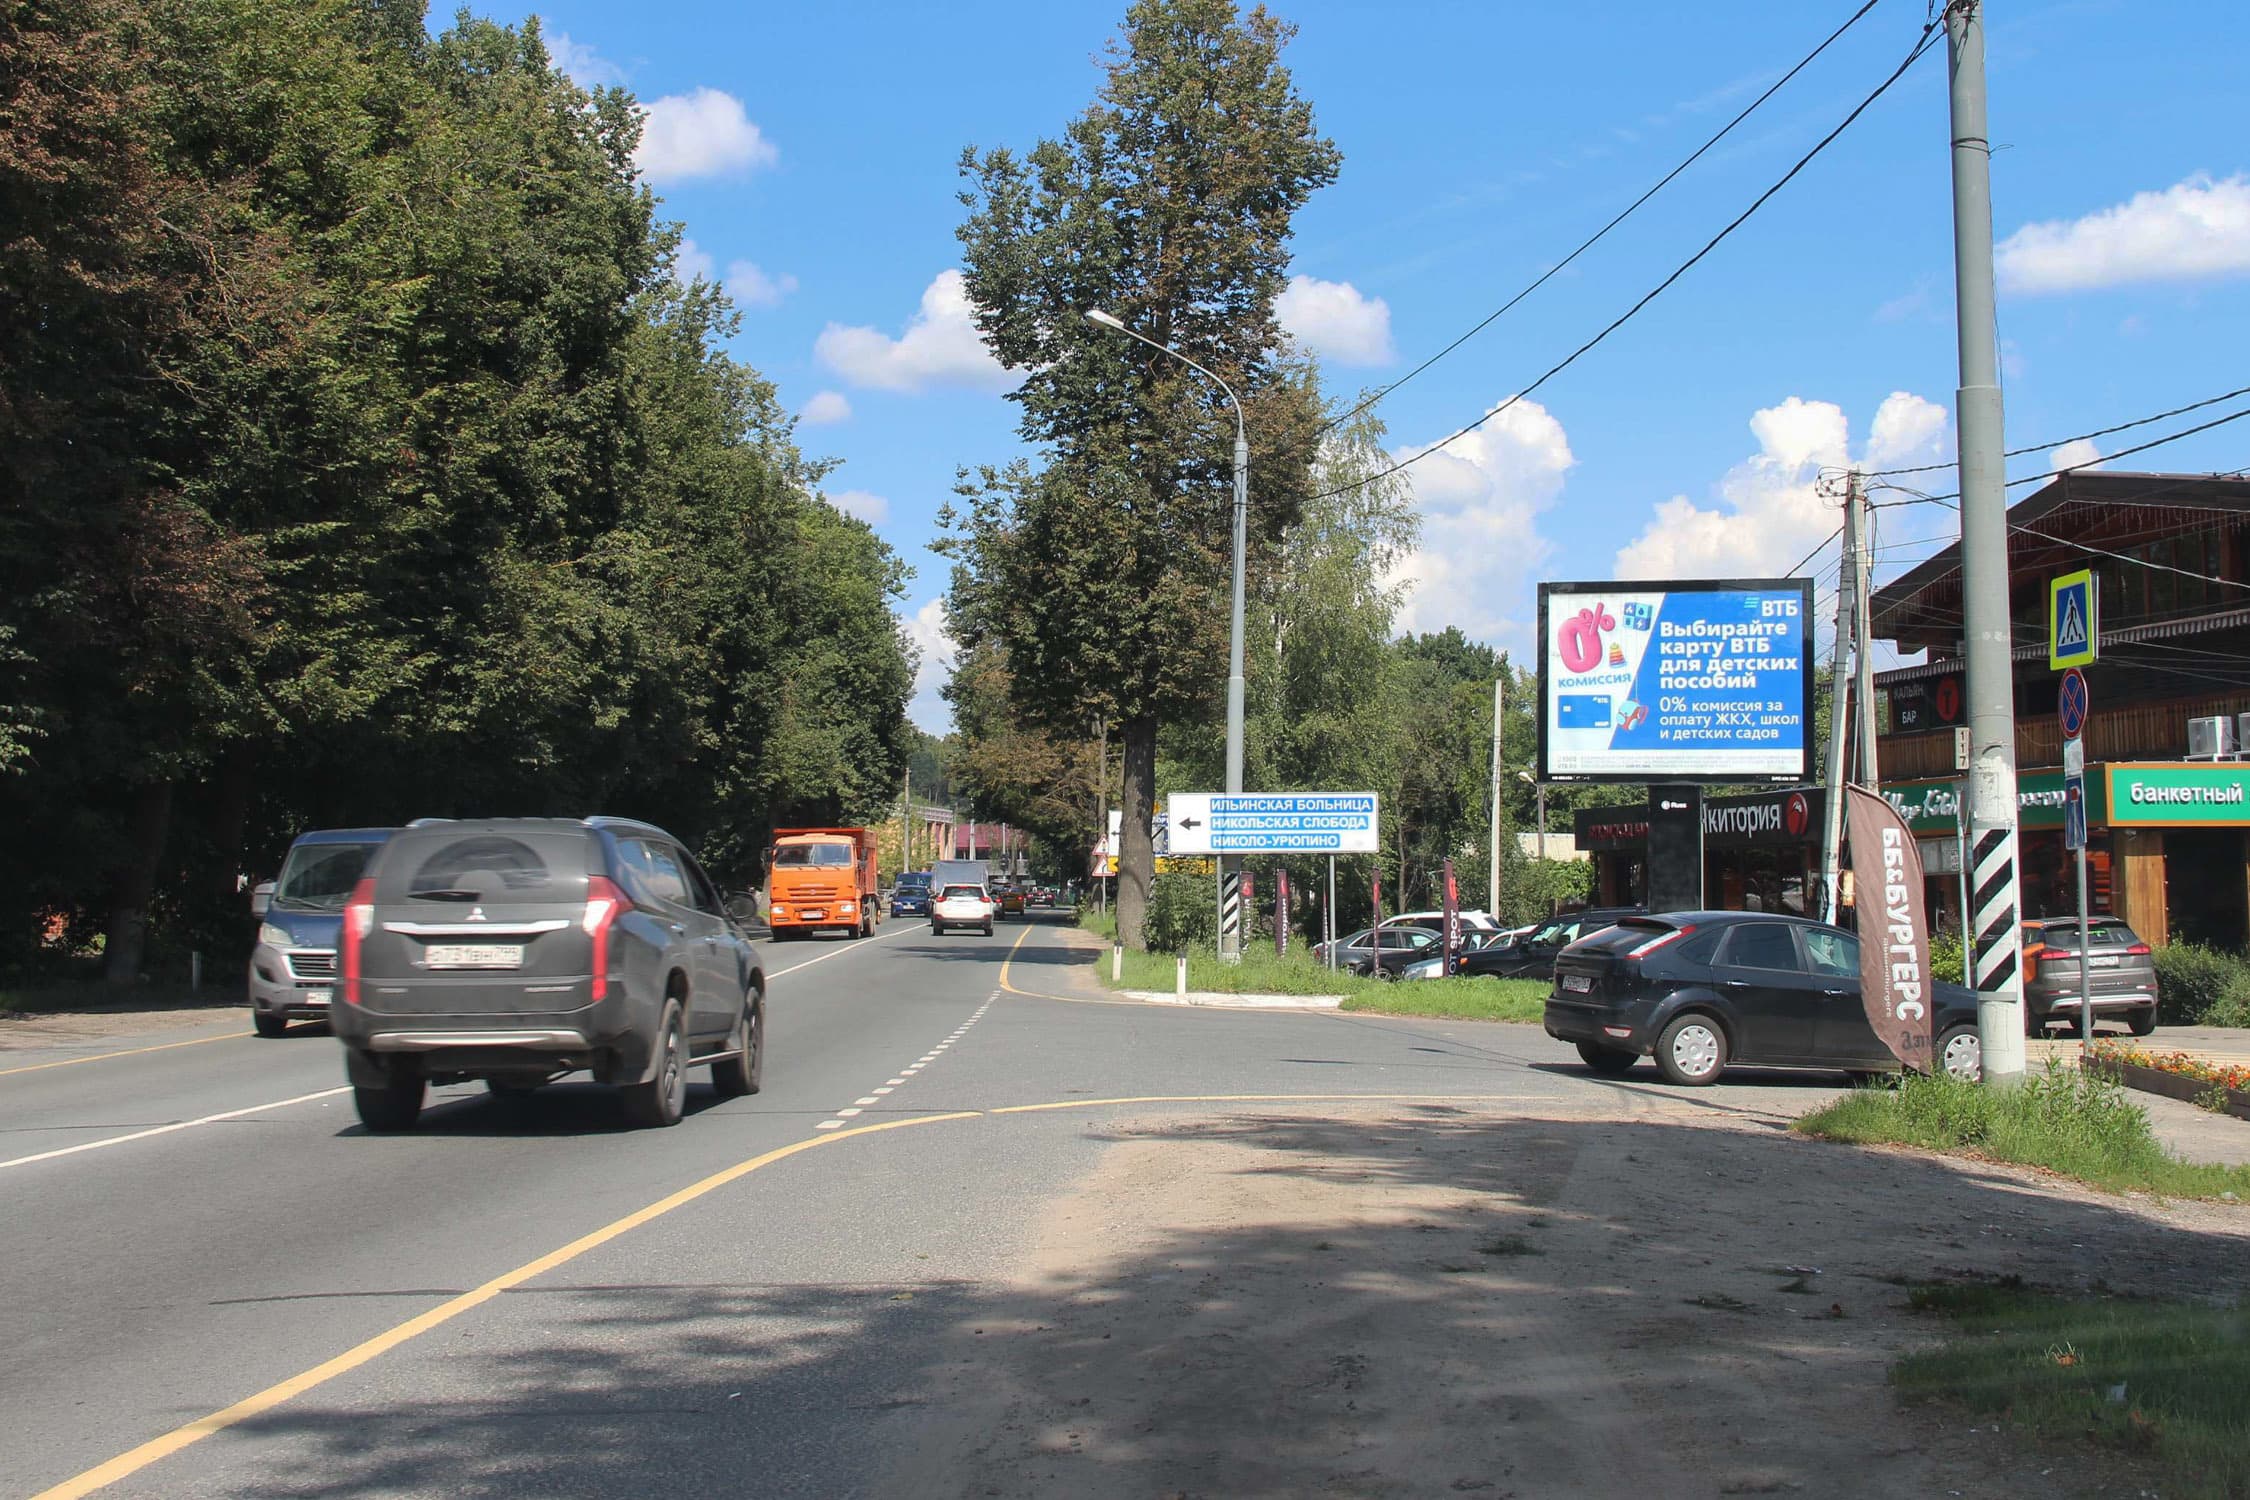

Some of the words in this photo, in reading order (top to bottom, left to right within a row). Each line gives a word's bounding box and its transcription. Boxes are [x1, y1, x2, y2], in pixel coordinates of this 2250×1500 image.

[1762, 600, 1798, 617] ВТБ
[1558, 602, 1615, 673] 0%
[1660, 620, 1787, 640] Выбирайте
[1660, 641, 1725, 658] карту
[1730, 638, 1770, 653] ВТБ
[1659, 659, 1700, 675] для
[1706, 657, 1798, 674] детских
[1660, 672, 1757, 689] пособий
[1660, 696, 1687, 712] 0%
[1692, 701, 1762, 712] комиссия
[1766, 701, 1783, 711] за
[1660, 714, 1711, 728] оплату
[1716, 713, 1756, 727] ЖКХ,
[1760, 714, 1799, 725] школ
[1902, 710, 1917, 724] БАР
[1660, 729, 1669, 738] и
[1673, 729, 1732, 740] детских
[1736, 729, 1779, 740] садов
[2130, 782, 2243, 803] банкетный
[1211, 799, 1293, 811] ИЛЬИНСКАЯ
[1296, 799, 1371, 812] БОЛЬНИЦА
[1212, 817, 1300, 829] НИКОЛЬСКАЯ
[1303, 816, 1367, 829] СЛОБОДА
[1212, 834, 1339, 847] НИКОЛО-УРЮПИНО
[1450, 909, 1458, 949] SPOT
